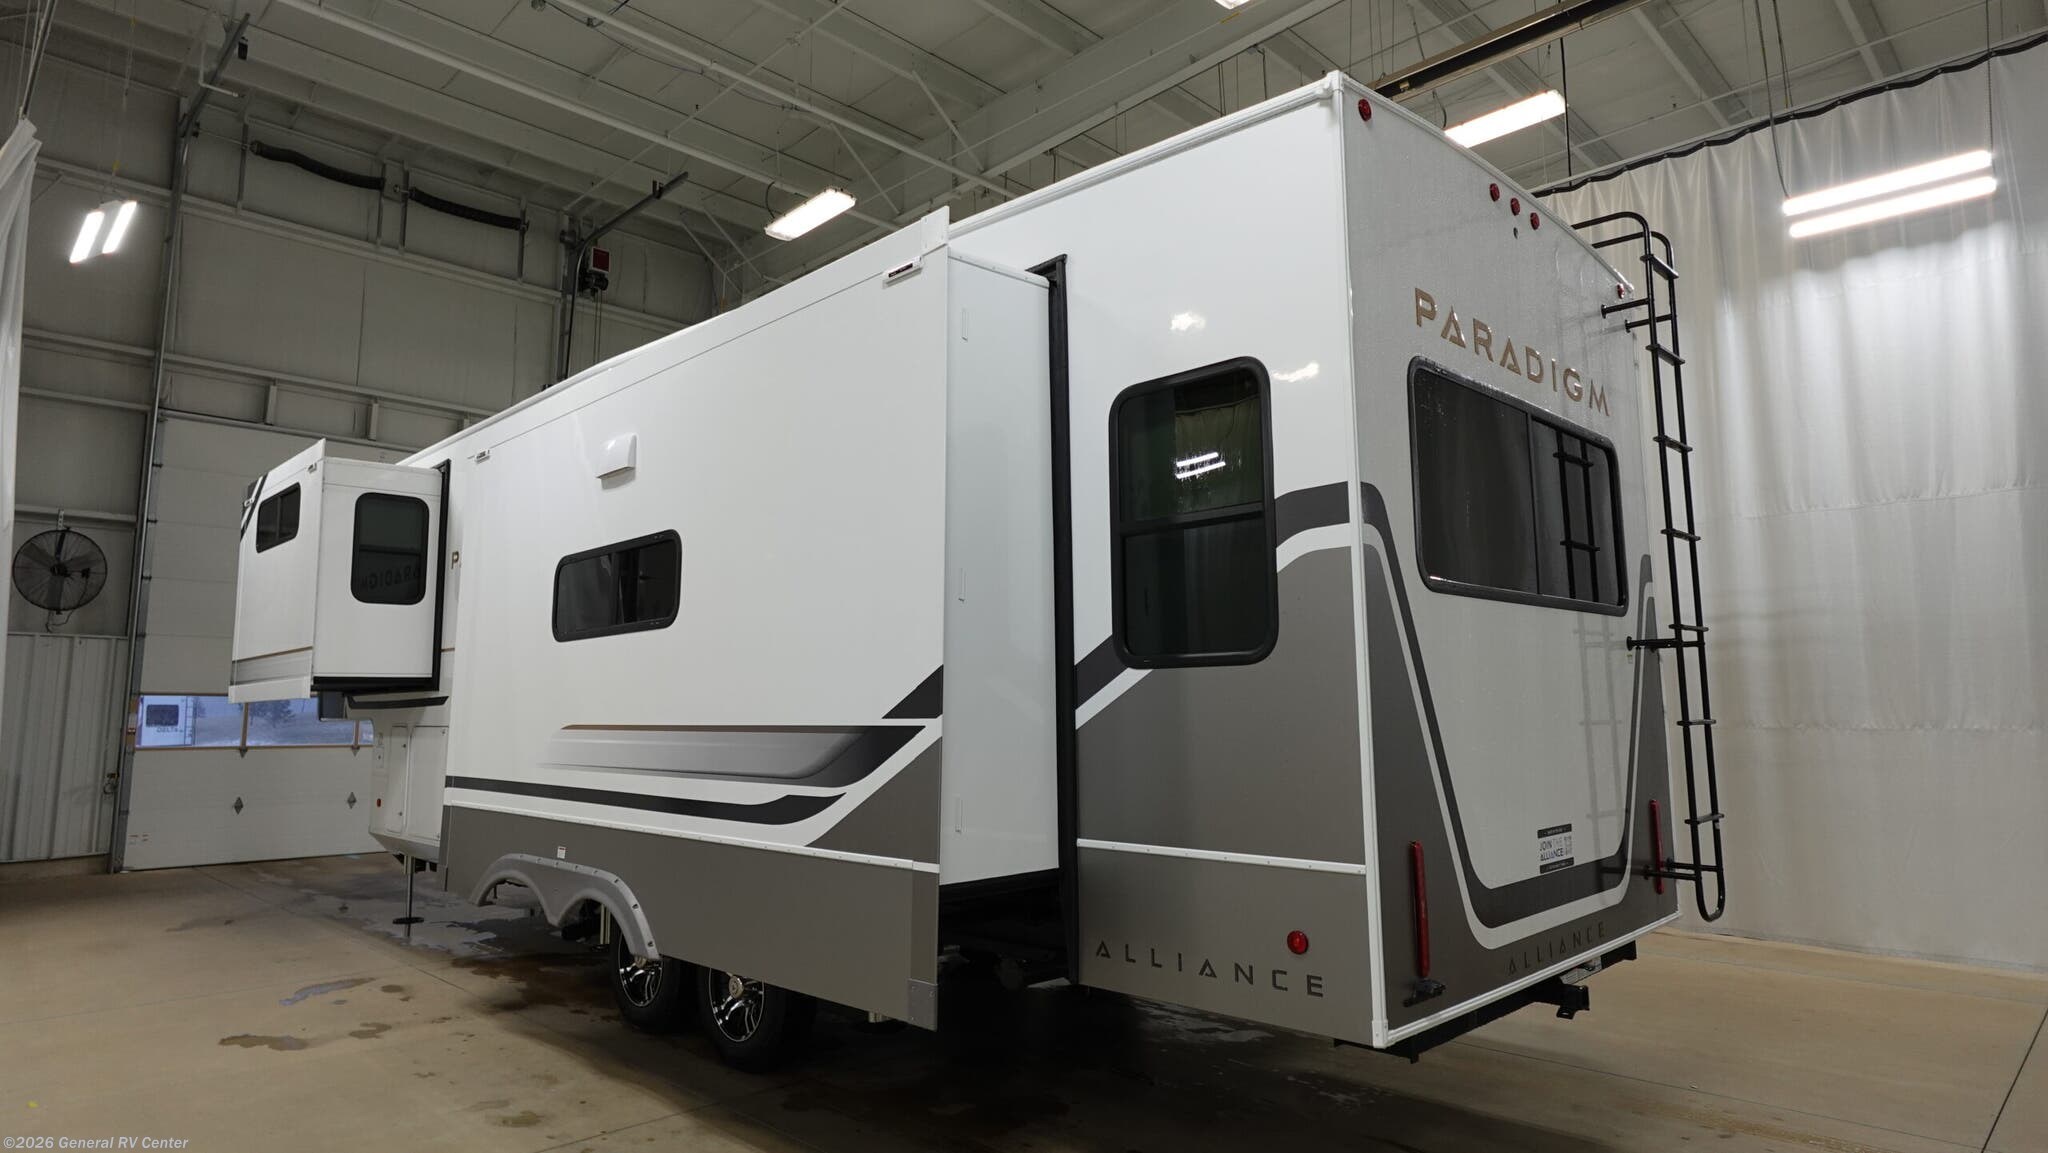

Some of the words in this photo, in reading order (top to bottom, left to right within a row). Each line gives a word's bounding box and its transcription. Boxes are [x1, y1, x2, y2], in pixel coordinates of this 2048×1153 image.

[1415, 287, 1610, 416] PARADIGM
[1540, 847, 1564, 861] ALLIANCE
[1096, 940, 1324, 998] ALLIANCE
[1508, 921, 1606, 976] ALLIANCE
